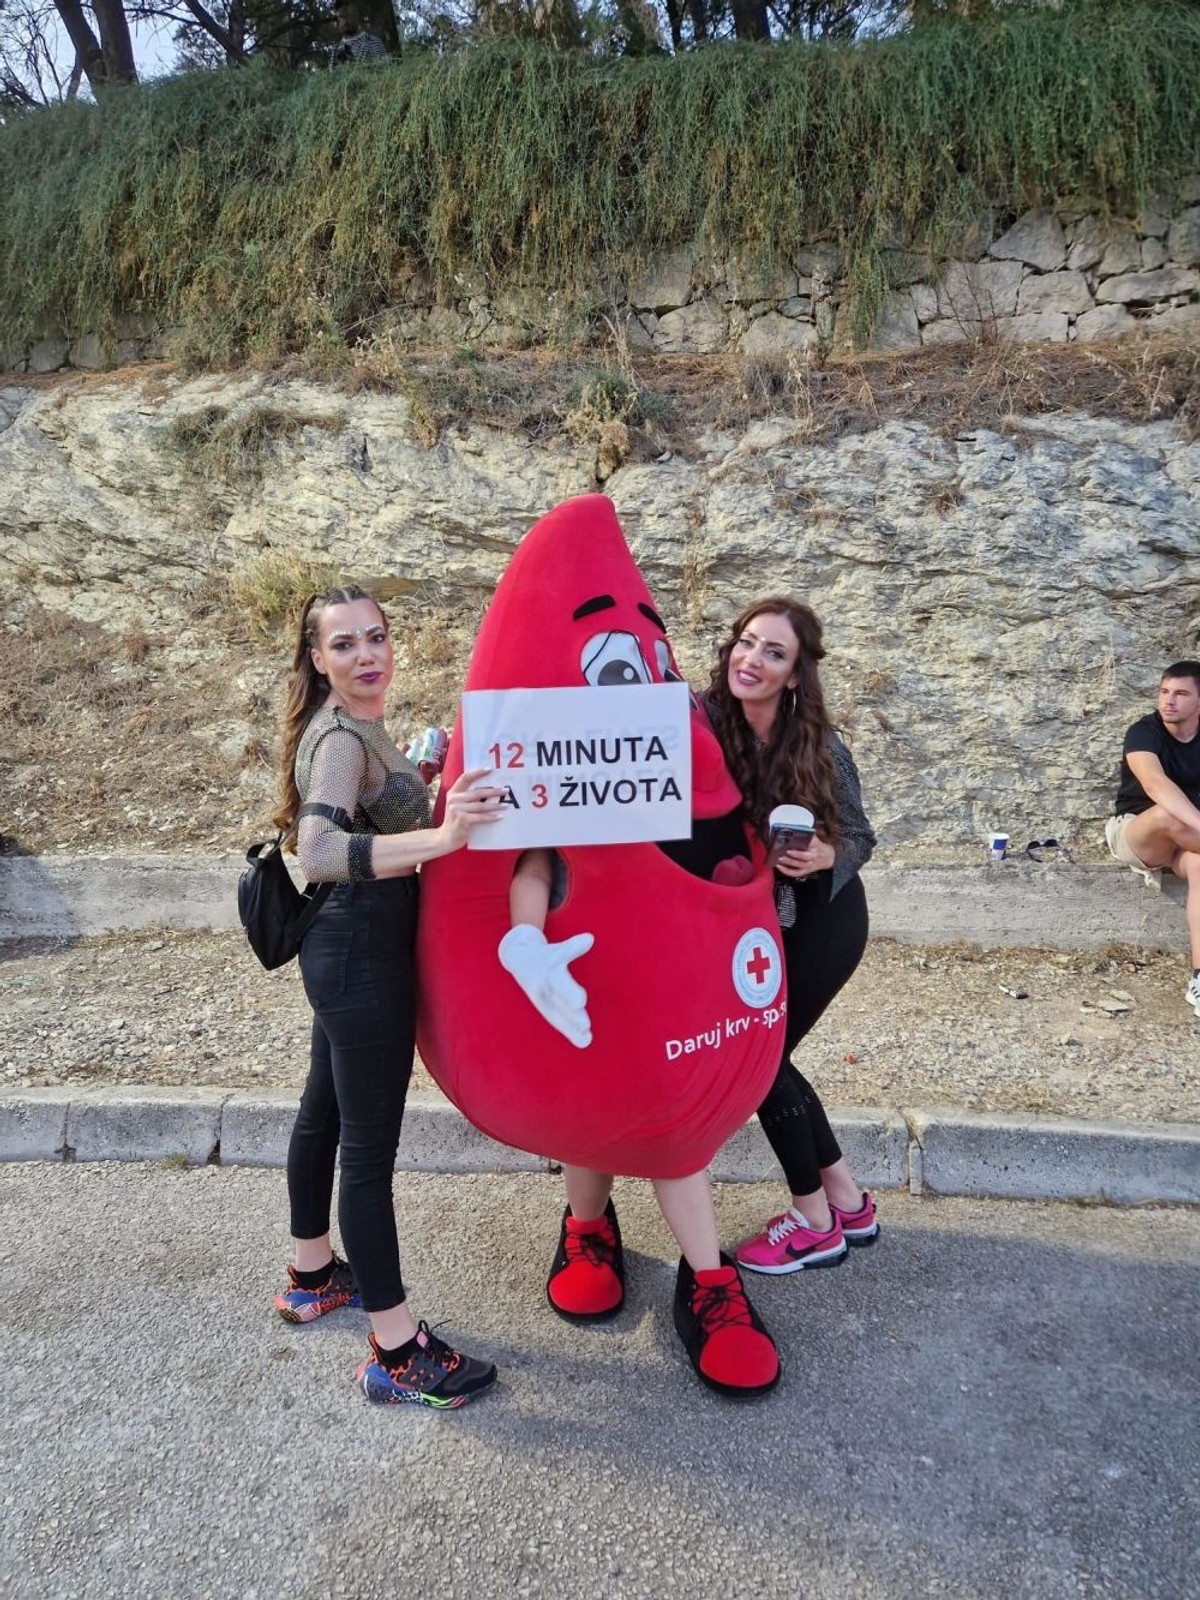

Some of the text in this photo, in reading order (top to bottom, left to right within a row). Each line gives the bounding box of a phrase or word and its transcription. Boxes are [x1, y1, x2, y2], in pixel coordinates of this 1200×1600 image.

[488, 736, 669, 769] 12 MINUTA
[531, 783, 549, 809] 3
[559, 776, 683, 808] ŽIVOTA
[665, 1022, 722, 1061] Daruj
[725, 1016, 751, 1038] krv
